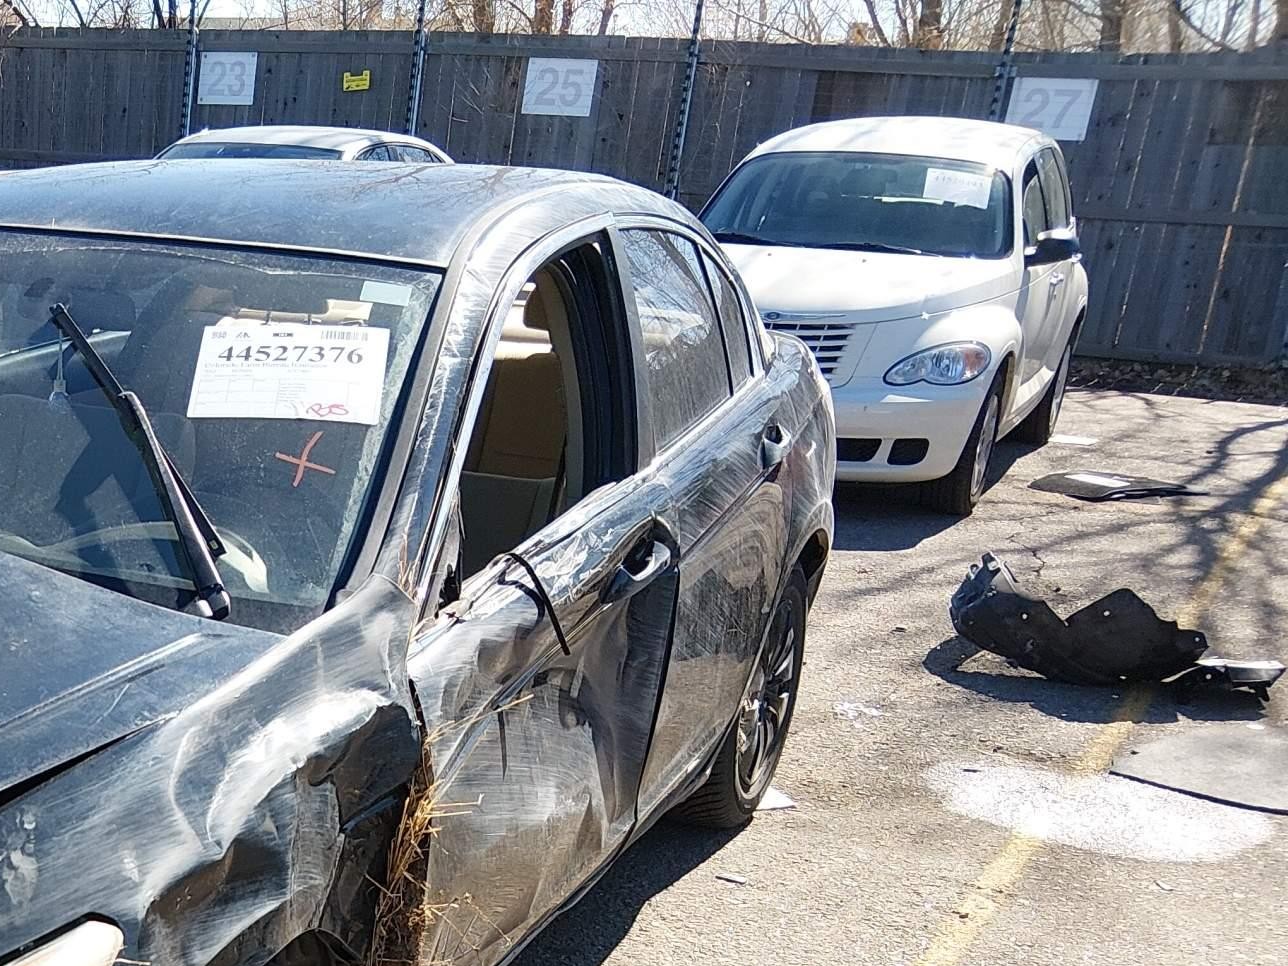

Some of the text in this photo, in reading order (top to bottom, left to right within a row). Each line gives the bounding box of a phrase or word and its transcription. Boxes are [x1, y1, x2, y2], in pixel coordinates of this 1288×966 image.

[208, 60, 247, 97] 23
[534, 67, 585, 107] 25
[1020, 87, 1083, 129] 27
[218, 345, 364, 365] 44527376
